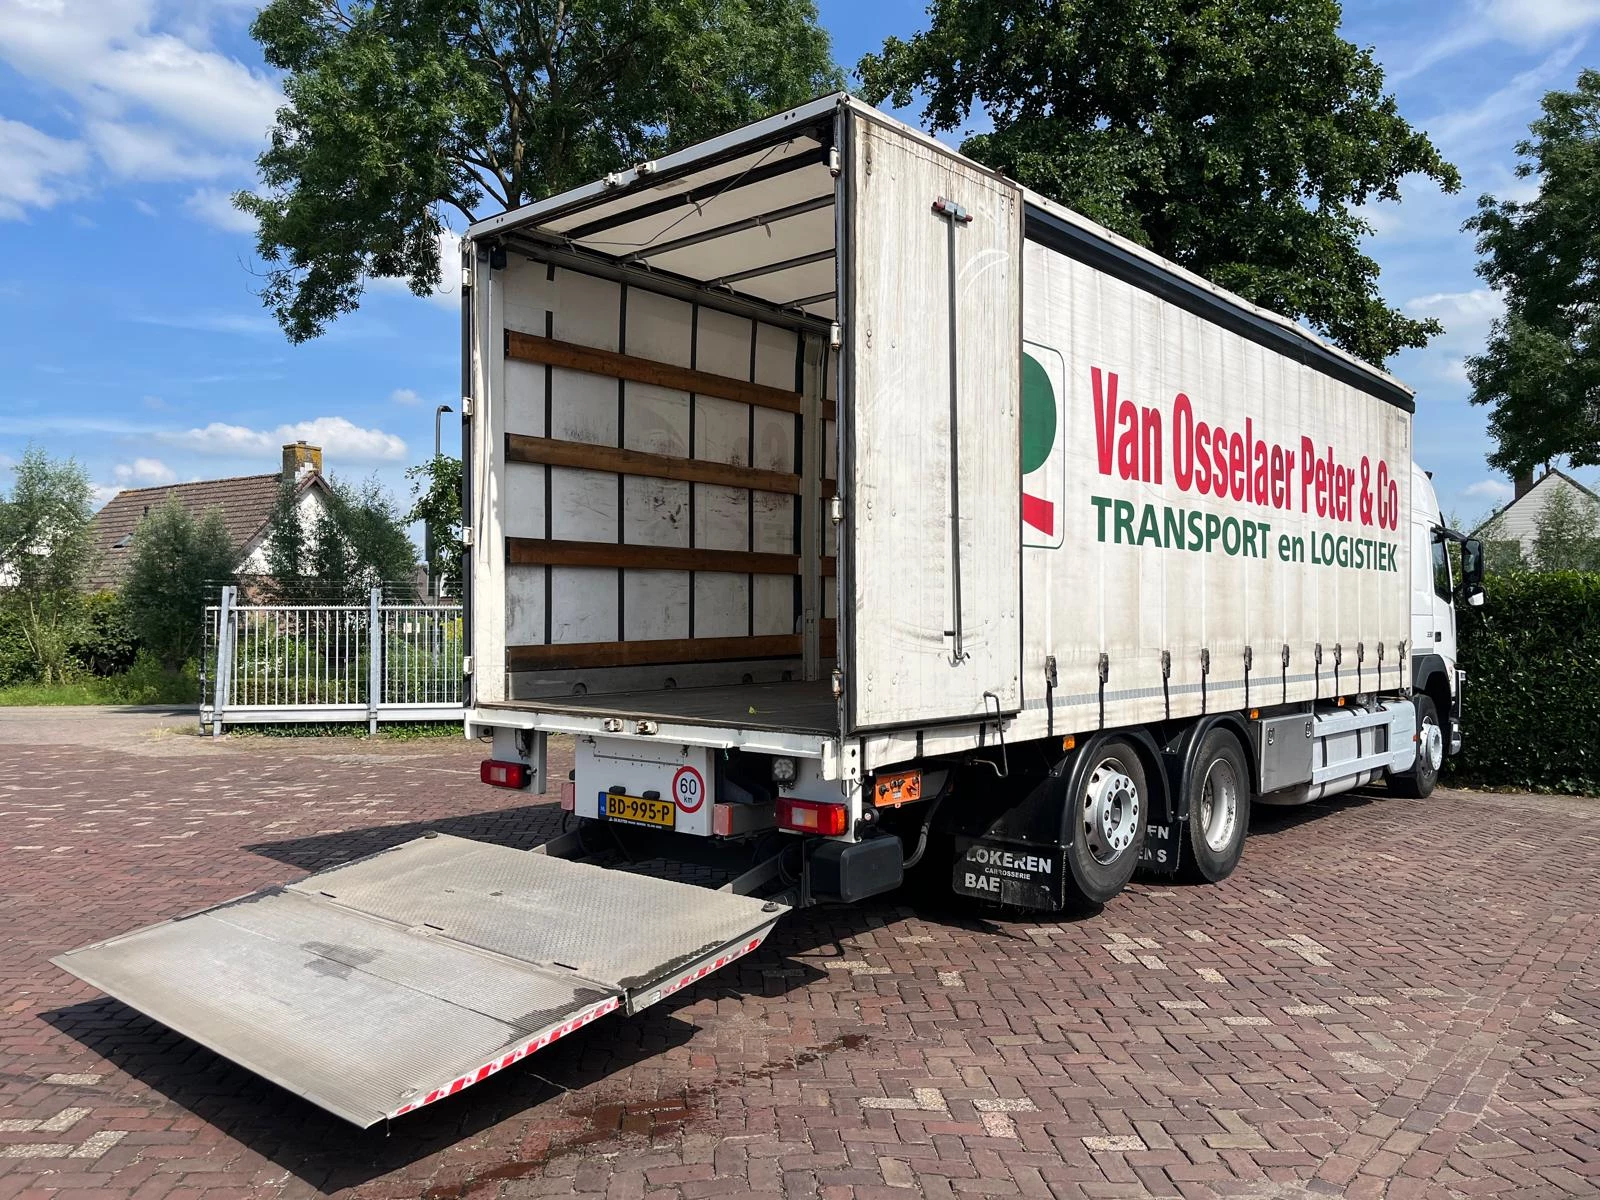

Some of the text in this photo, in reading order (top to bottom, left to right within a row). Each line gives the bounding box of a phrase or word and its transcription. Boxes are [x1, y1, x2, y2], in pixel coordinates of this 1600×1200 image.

[1091, 366, 1398, 532] Van Osselaer Peter & Co
[1091, 495, 1398, 573] TRANSPORT en LOGISTIEK
[680, 778, 697, 795] 60
[609, 798, 670, 822] BD-995-P
[683, 796, 693, 804] km
